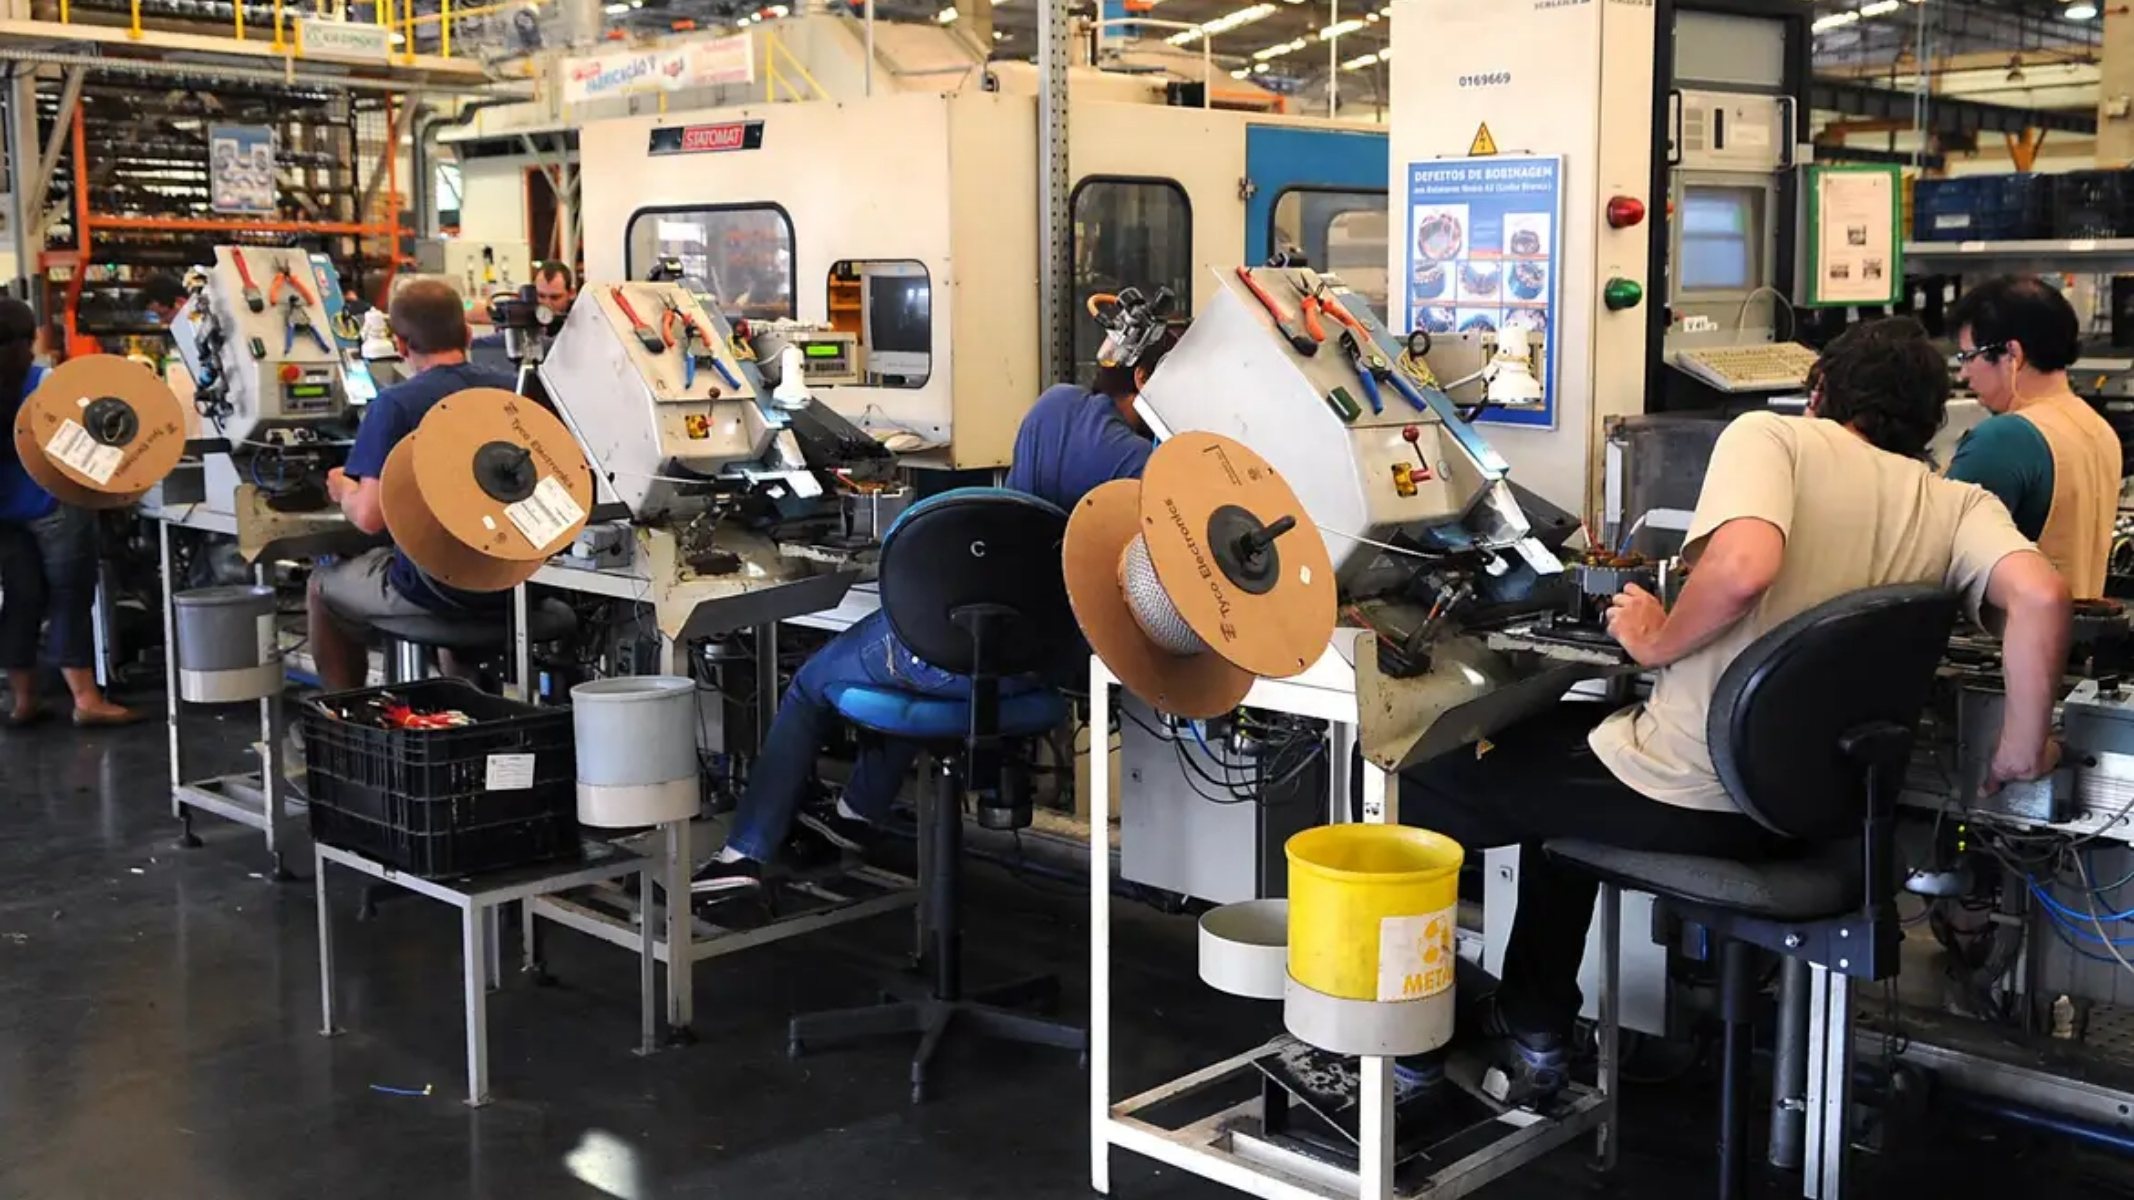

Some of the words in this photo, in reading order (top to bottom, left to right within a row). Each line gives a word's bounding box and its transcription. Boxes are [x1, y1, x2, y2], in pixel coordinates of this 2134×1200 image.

[1458, 72, 1511, 87] 0169669
[685, 126, 741, 148] STATOMAT
[1414, 169, 1465, 182] DEFEITOS
[1468, 168, 1482, 180] DE
[1484, 166, 1553, 180] BOBINAGEM
[511, 417, 531, 441] Tyco
[530, 439, 575, 490] Electronics
[970, 541, 986, 557] C
[1163, 497, 1213, 580] Electronics
[1210, 581, 1231, 619] Tyco
